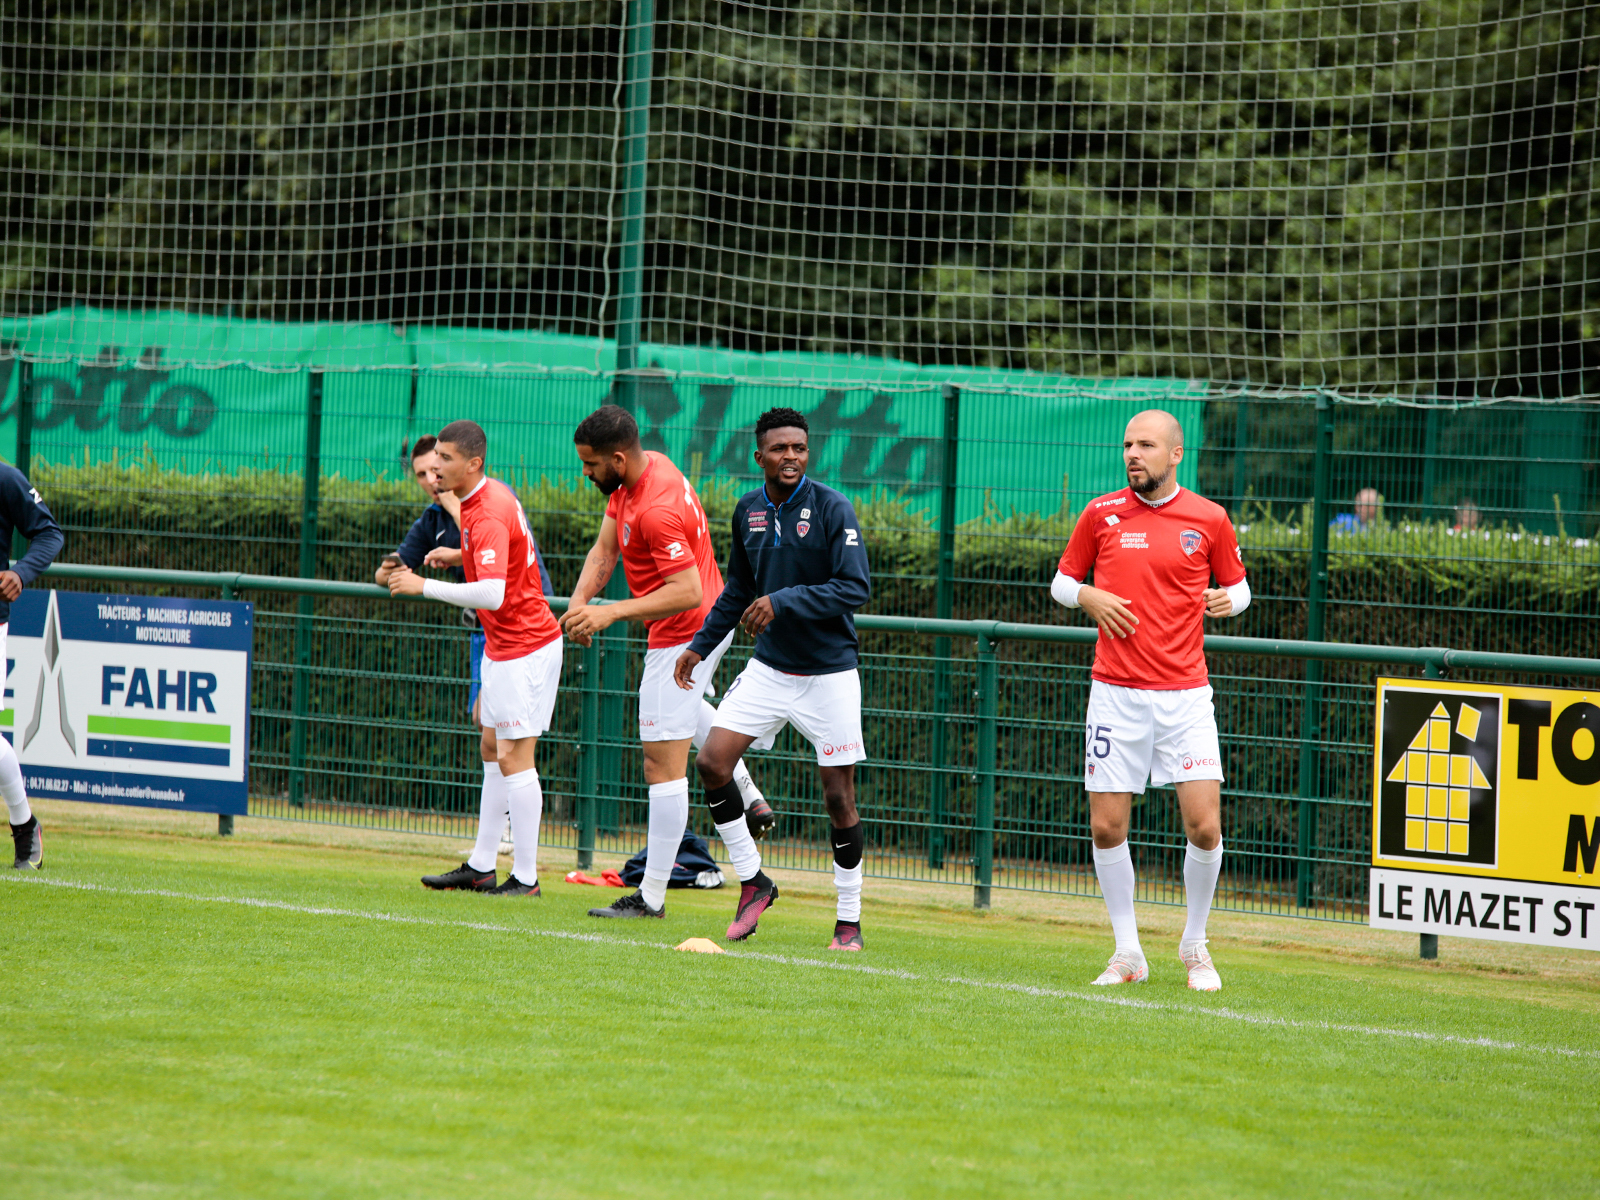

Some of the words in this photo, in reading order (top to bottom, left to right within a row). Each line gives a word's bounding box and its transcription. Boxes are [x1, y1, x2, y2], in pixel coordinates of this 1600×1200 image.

[97, 604, 142, 621] TRACTEURS
[146, 607, 188, 624] MACHINES
[187, 610, 232, 627] AGRICOLES
[135, 626, 191, 644] MOTOCULTURE
[101, 665, 217, 714] FAHR
[1507, 698, 1600, 786] TO
[1378, 883, 1413, 921] LE
[1423, 887, 1544, 934] MAZET
[1553, 899, 1595, 939] ST
